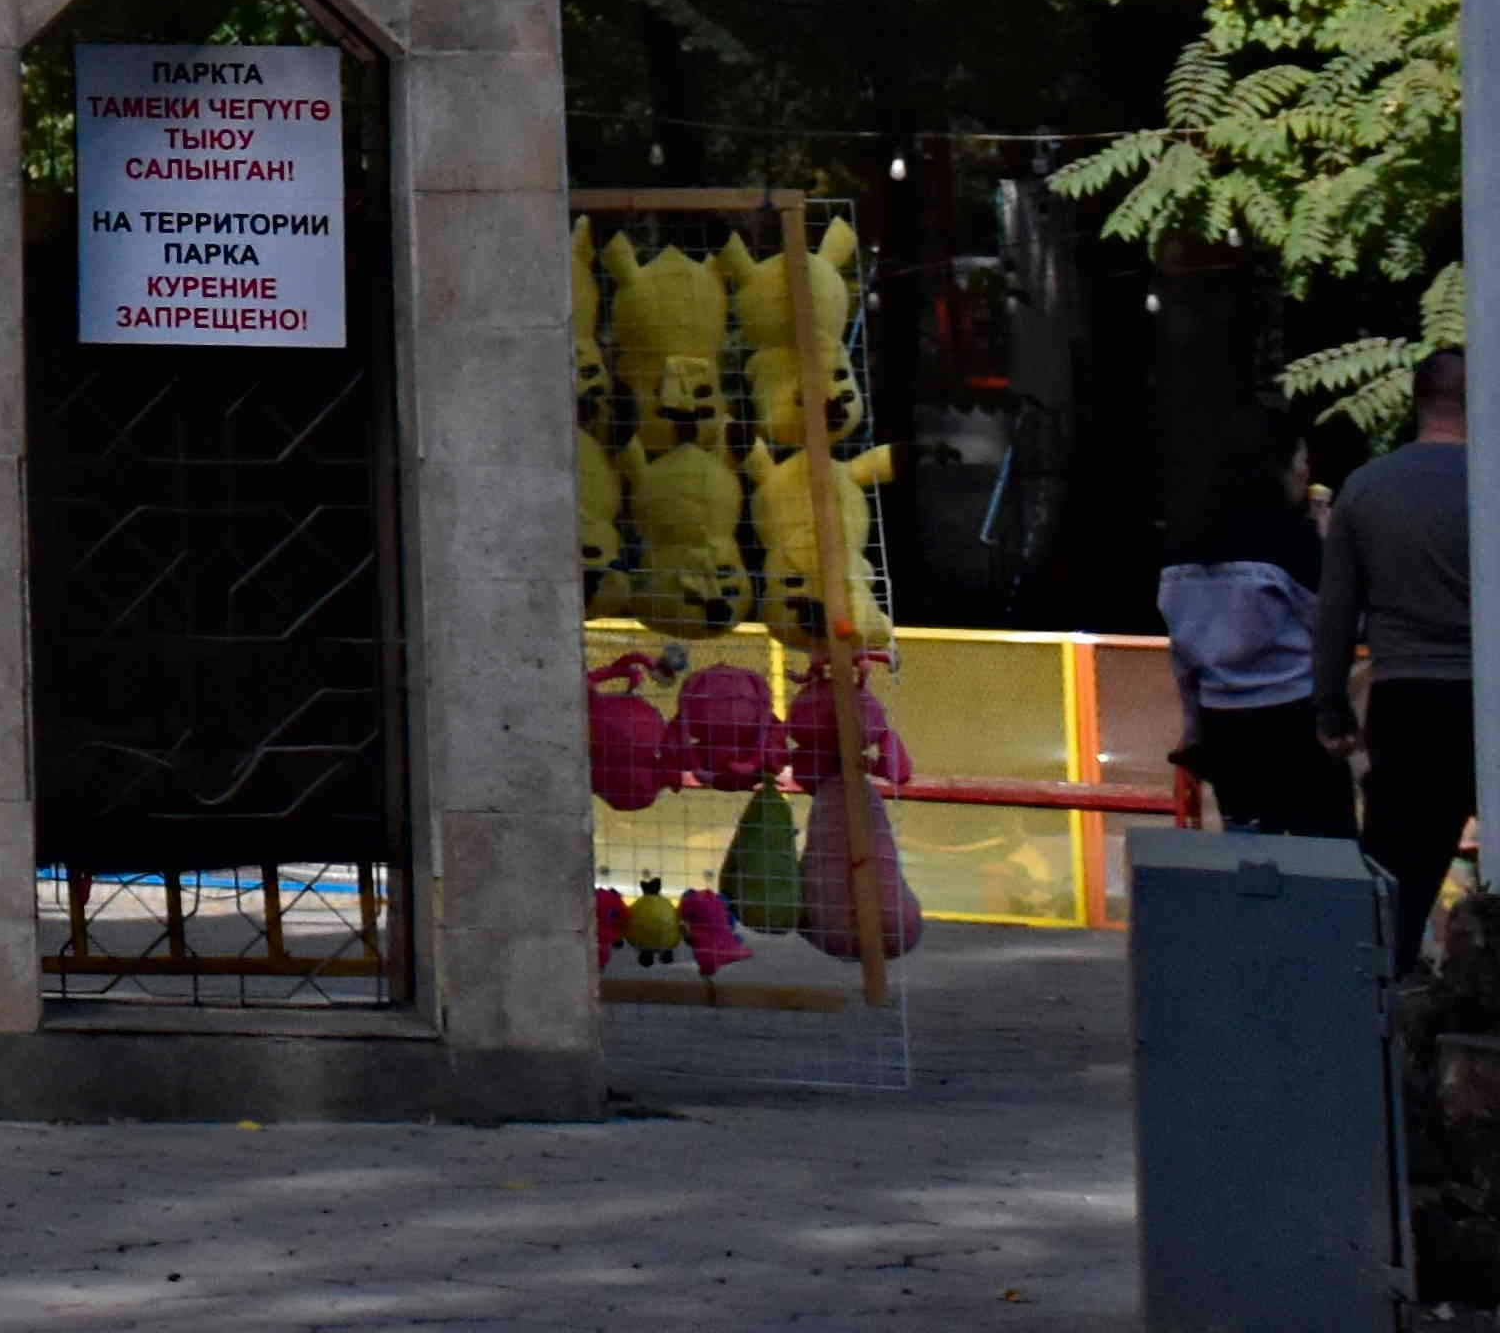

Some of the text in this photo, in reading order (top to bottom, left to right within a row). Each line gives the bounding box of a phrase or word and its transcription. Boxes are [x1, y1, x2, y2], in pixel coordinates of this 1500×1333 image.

[153, 62, 263, 84] ПАРКТА
[87, 96, 331, 121] ТАМЕКИ ЧЕГҮҮГӨ
[164, 128, 254, 150] ТЫЮУ
[125, 158, 295, 181] САЛЫНГАН!
[93, 211, 329, 235] НА ТЕРРИТОРИИ
[164, 243, 260, 265] ПАРКА
[147, 276, 277, 299] КУРЕНИЕ
[117, 306, 307, 332] ЗАПРЕЩЕНО!
